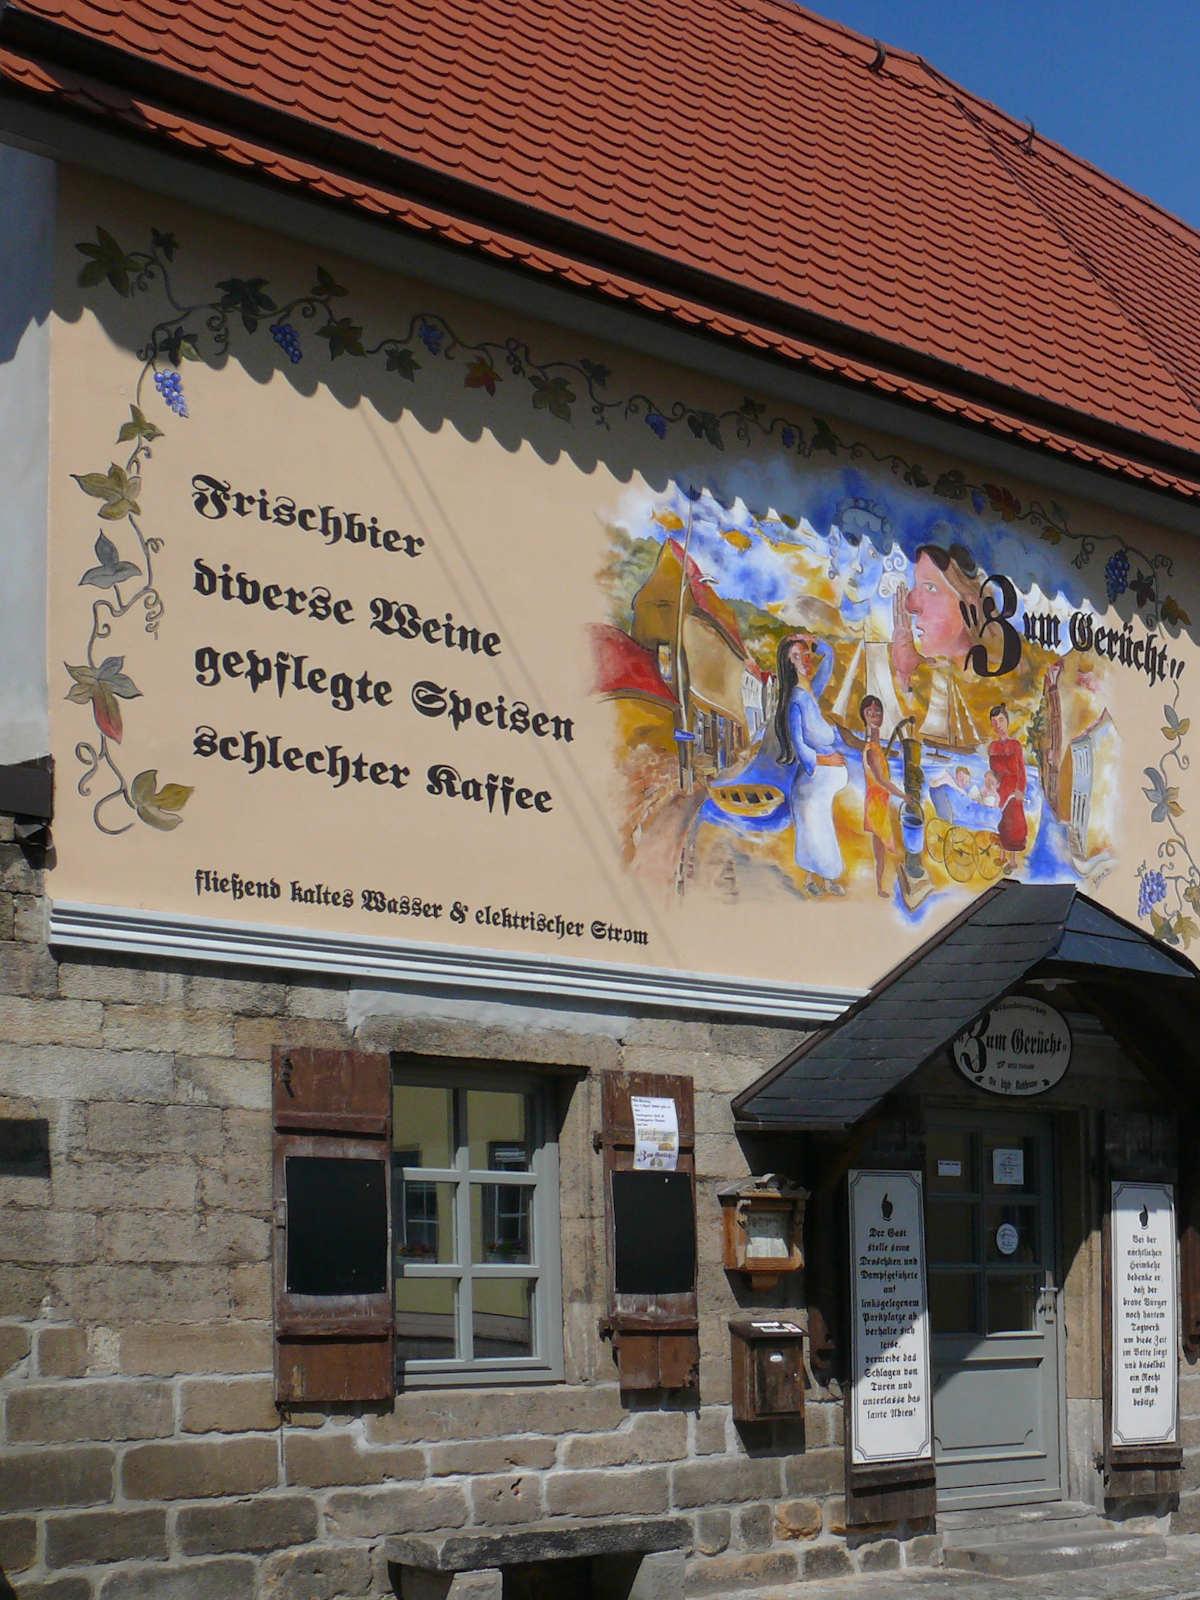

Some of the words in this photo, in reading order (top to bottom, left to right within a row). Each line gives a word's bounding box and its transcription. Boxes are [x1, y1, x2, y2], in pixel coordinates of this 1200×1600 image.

[192, 474, 424, 558] Frischbier
[193, 558, 354, 624] diverse
[370, 597, 501, 657] Weine
[195, 645, 393, 711] gepflegte
[411, 680, 574, 743] Speisen
[193, 725, 410, 788] schlechter
[426, 764, 553, 815] Kaffee
[194, 869, 281, 900] fließend
[290, 880, 354, 908] kaltes
[361, 888, 442, 919] Wasser
[450, 901, 468, 923] &
[475, 905, 584, 940] elektrischer
[591, 920, 649, 946] Strom
